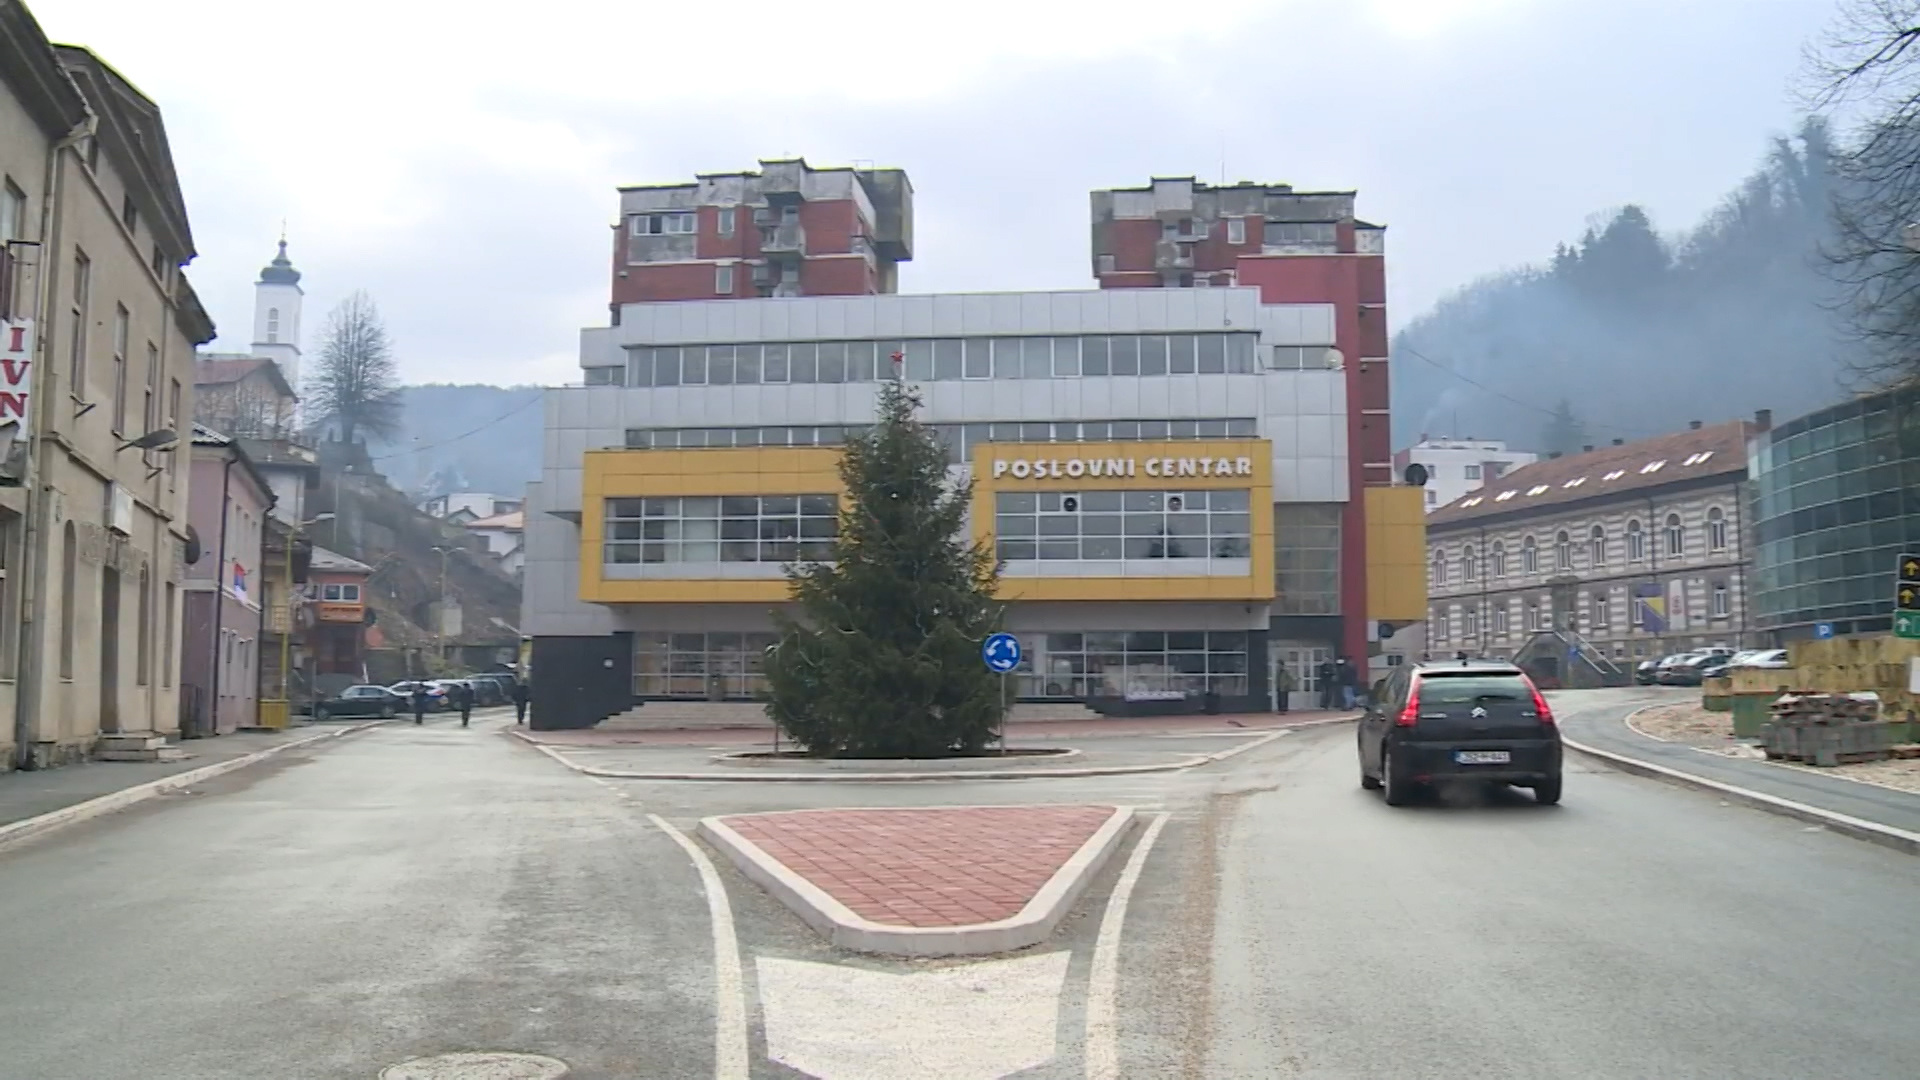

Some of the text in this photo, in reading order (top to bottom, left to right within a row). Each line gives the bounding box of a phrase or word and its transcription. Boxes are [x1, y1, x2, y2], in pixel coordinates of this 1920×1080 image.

[993, 457, 1252, 479] POSLOVNI CENTAR
[1819, 624, 1829, 636] P
